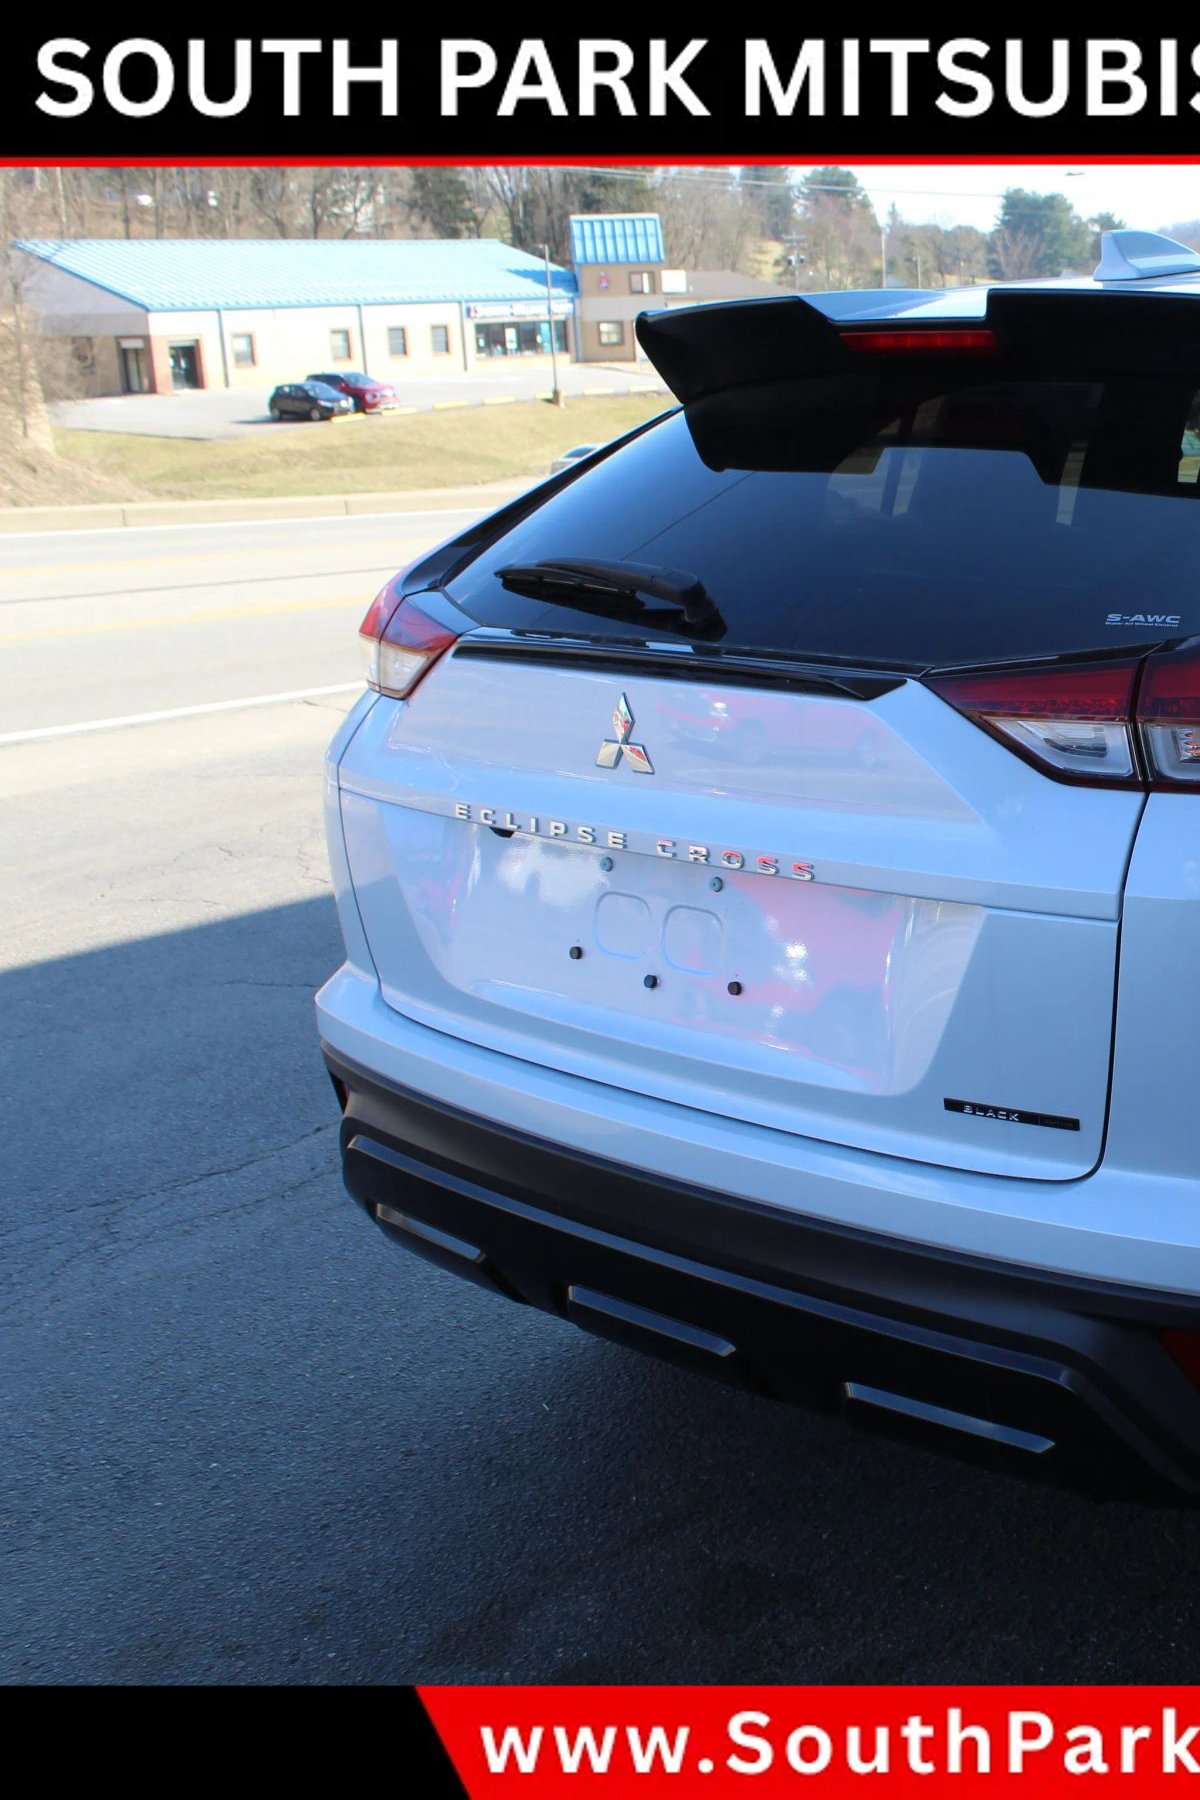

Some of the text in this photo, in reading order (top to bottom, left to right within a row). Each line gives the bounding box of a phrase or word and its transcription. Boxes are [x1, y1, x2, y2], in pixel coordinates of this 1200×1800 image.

[1106, 613, 1181, 623] S-AWC
[455, 802, 815, 882] ECLIPSE CROSS
[963, 1104, 1020, 1122] BLACK
